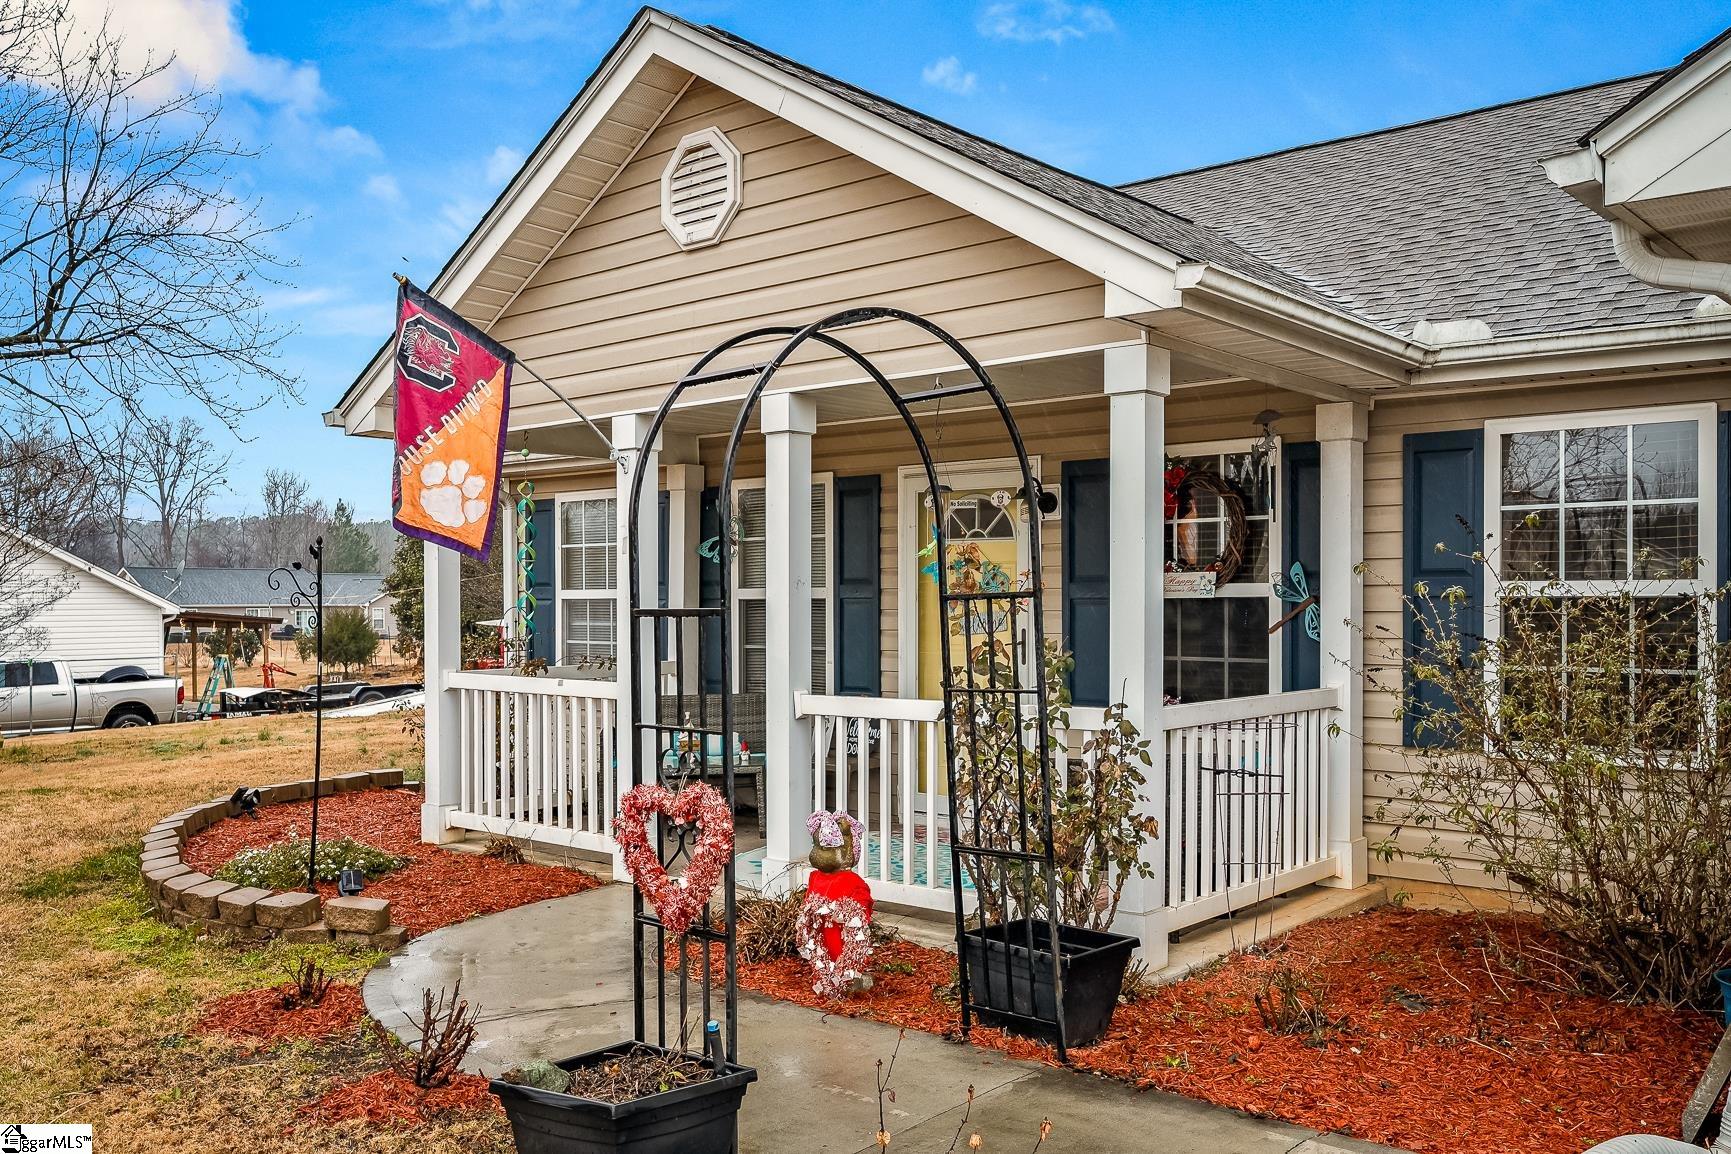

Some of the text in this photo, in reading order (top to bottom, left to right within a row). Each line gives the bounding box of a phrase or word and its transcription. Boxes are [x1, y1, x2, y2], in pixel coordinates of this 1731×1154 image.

[399, 379, 492, 476] OUSE DIVIDED
[1167, 576, 1197, 586] Happy
